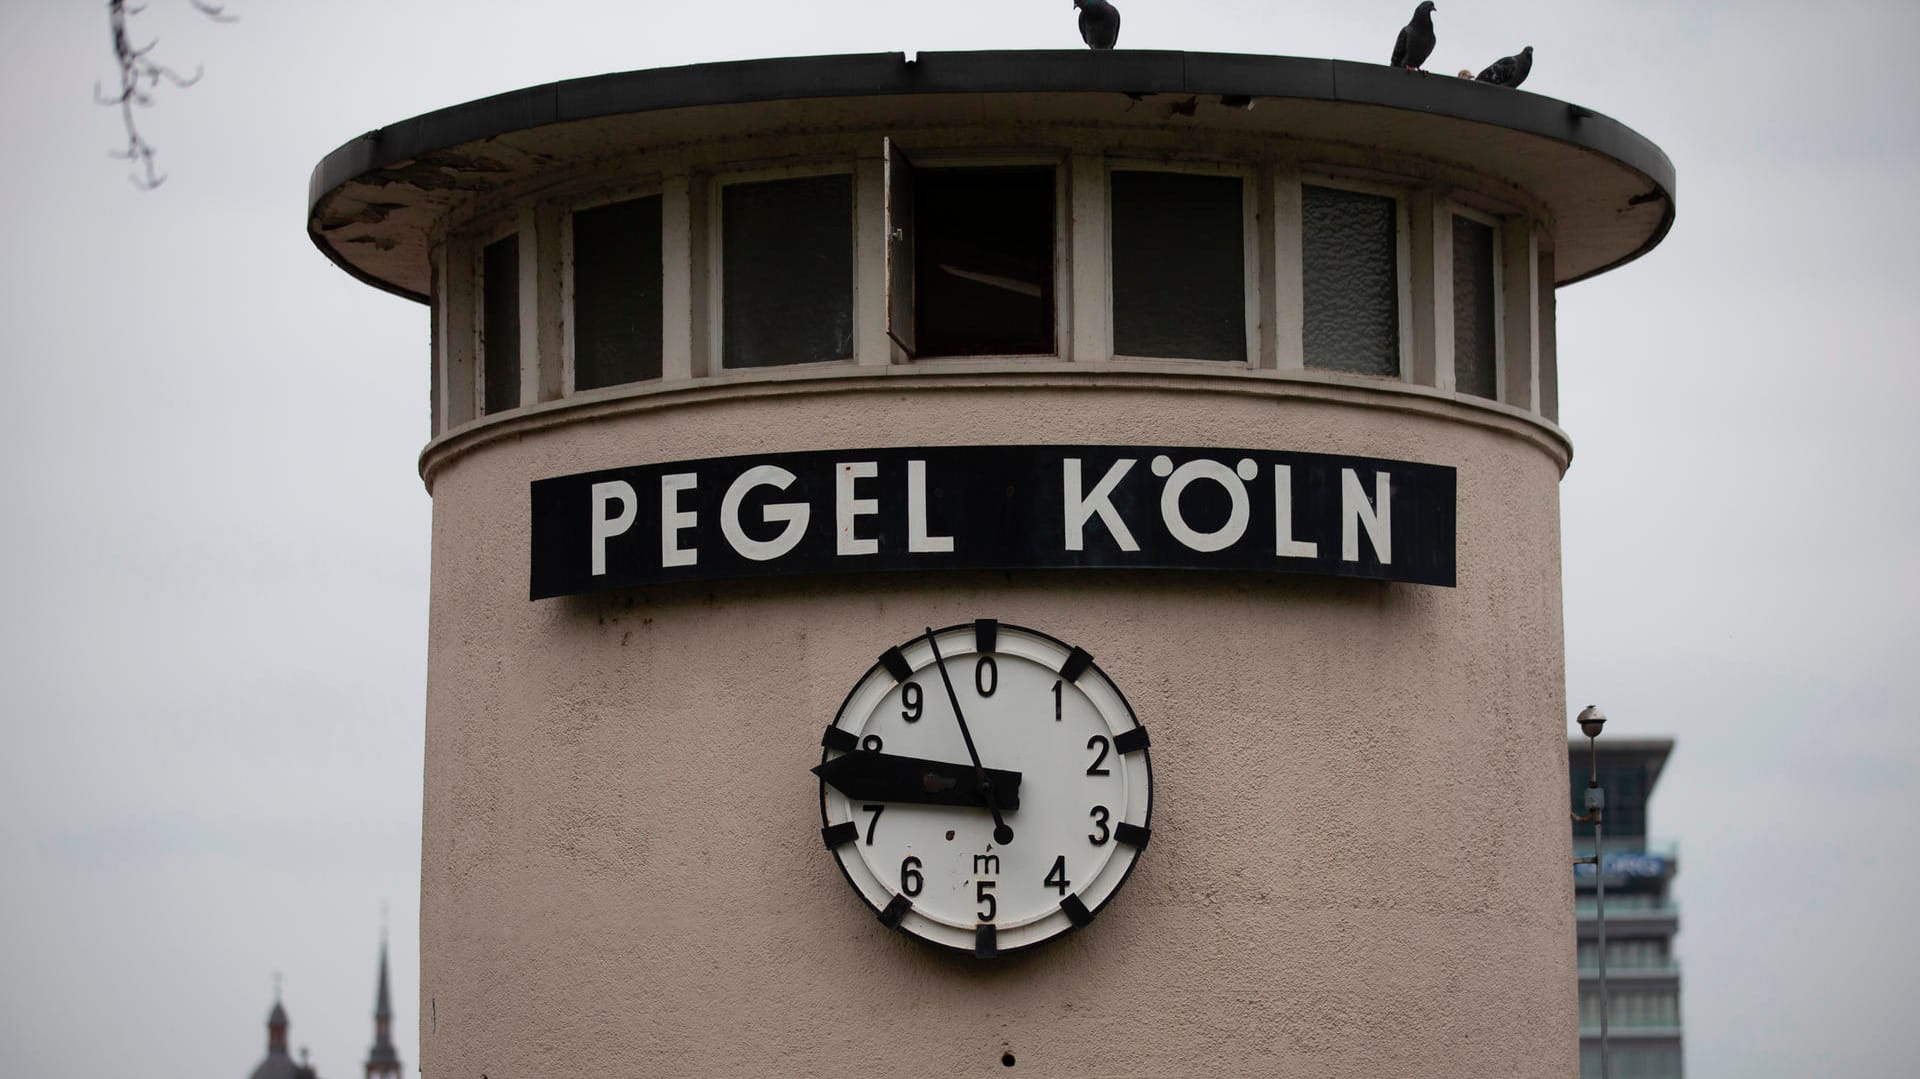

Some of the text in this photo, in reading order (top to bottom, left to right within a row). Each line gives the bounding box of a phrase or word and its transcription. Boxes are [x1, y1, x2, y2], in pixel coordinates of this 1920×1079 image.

[591, 454, 1392, 575] PEGEL KÖLN
[975, 656, 998, 697] 0
[902, 682, 923, 723] 9
[1051, 680, 1062, 721] 1
[1087, 735, 1110, 776] 2
[862, 805, 885, 845] 7
[1088, 806, 1110, 846] 3
[901, 856, 924, 897] 6
[974, 855, 999, 874] m
[1044, 856, 1070, 895] 4
[977, 881, 997, 922] 5
